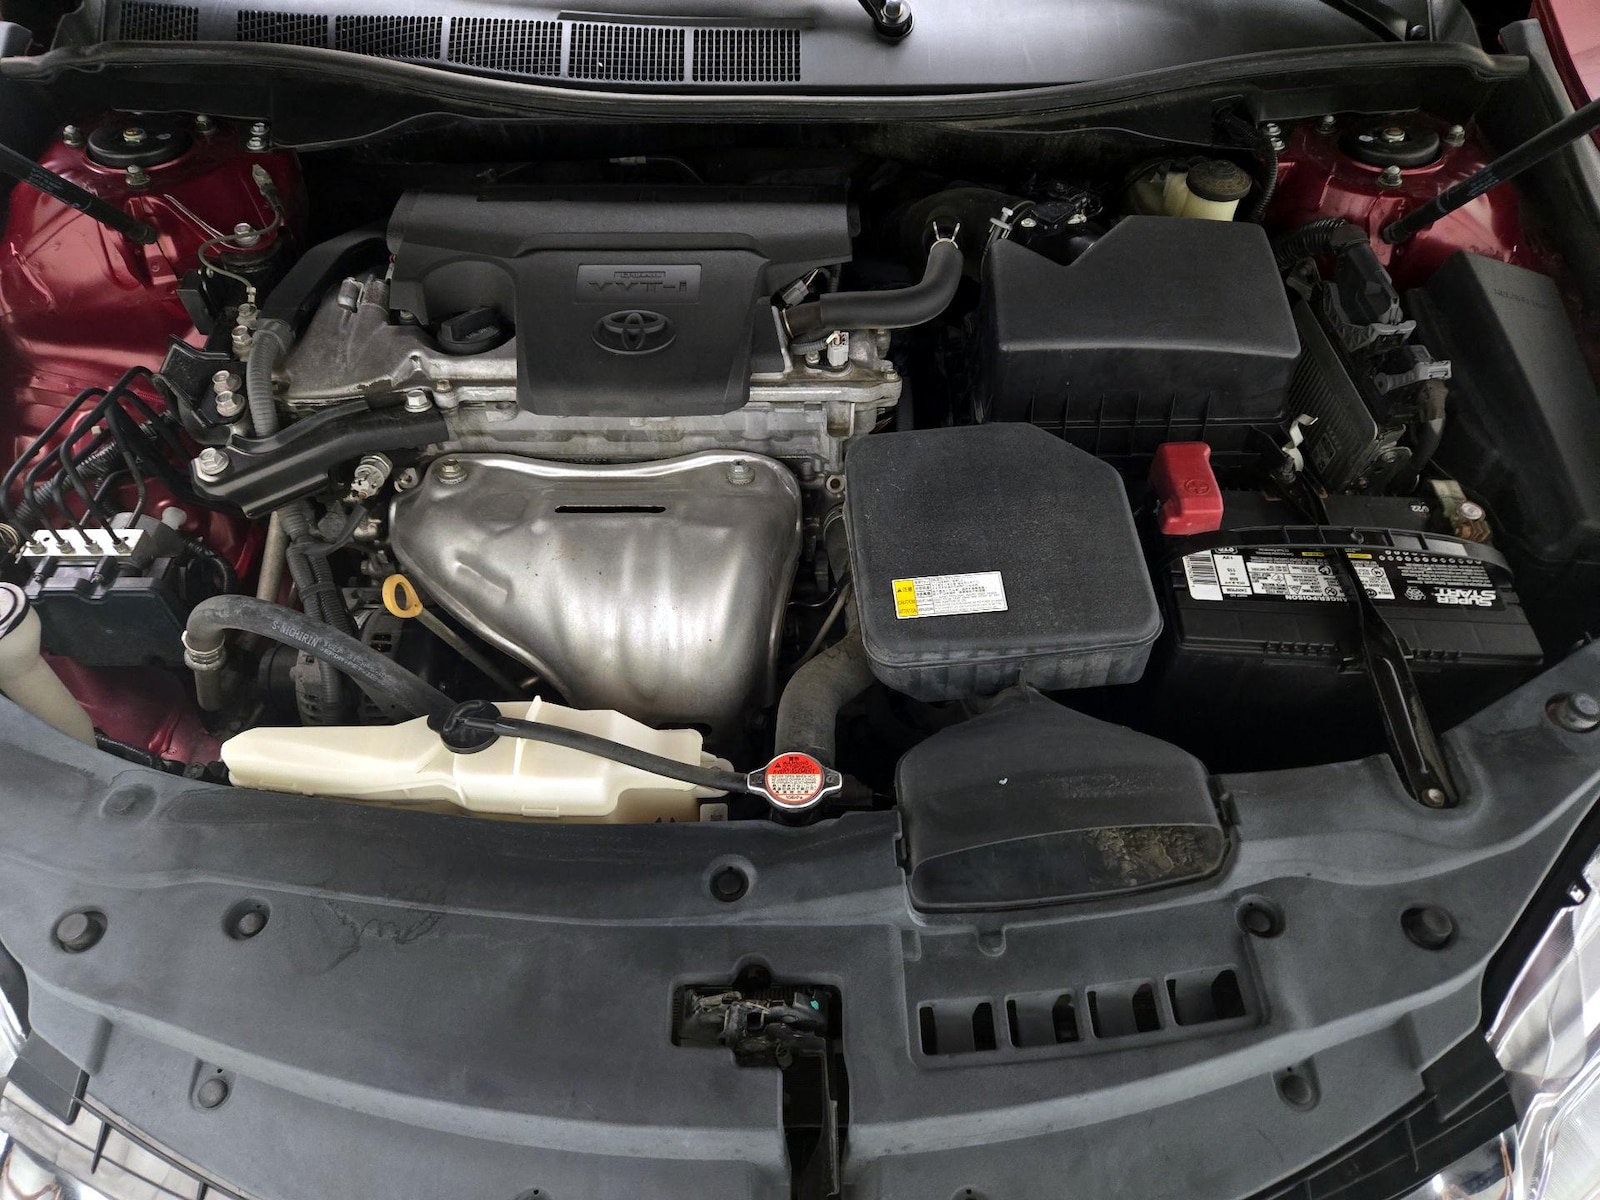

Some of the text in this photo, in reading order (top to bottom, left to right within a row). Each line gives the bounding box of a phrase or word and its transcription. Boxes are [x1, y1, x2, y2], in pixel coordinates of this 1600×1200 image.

[1284, 594, 1348, 603] ANGER/POISON
[1434, 587, 1496, 601] START
[1437, 596, 1493, 607] SUPER
